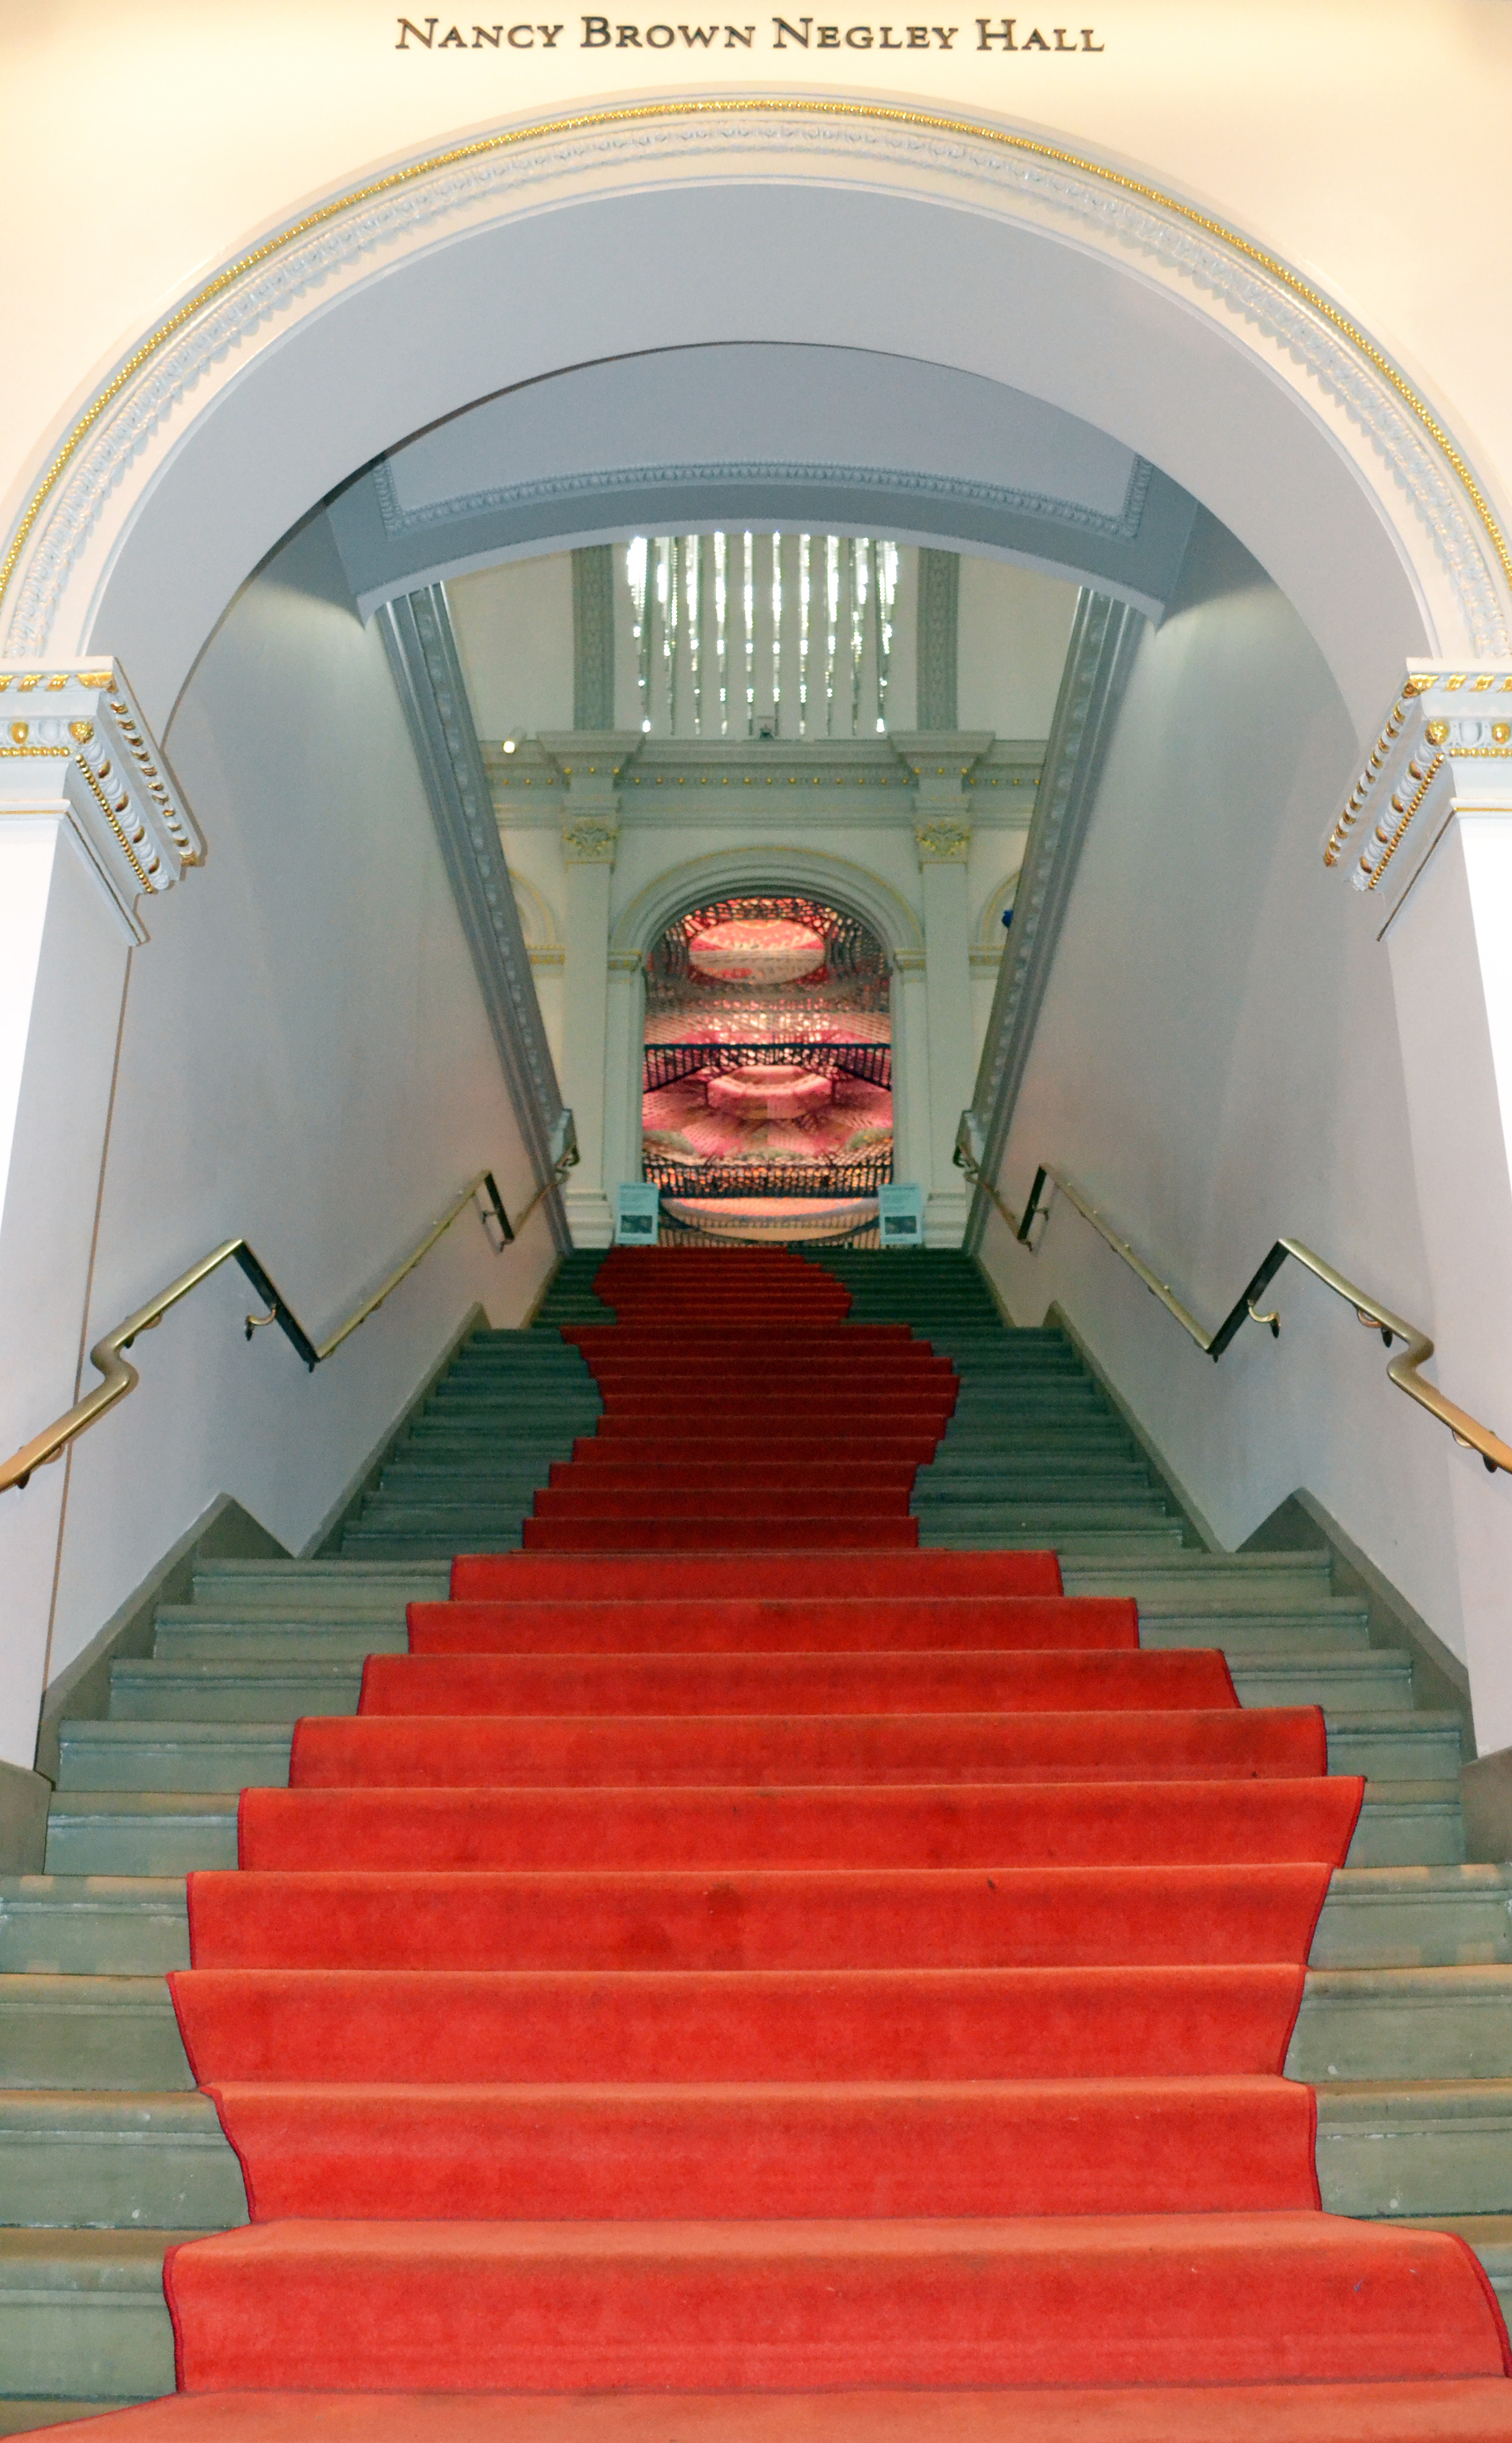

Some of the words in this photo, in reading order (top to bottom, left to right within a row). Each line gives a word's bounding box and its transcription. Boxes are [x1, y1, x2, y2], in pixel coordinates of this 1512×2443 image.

[394, 17, 564, 49] NANCY
[580, 16, 756, 49] BROWN
[771, 17, 959, 50] NEGLEY
[975, 19, 1105, 52] HALL
